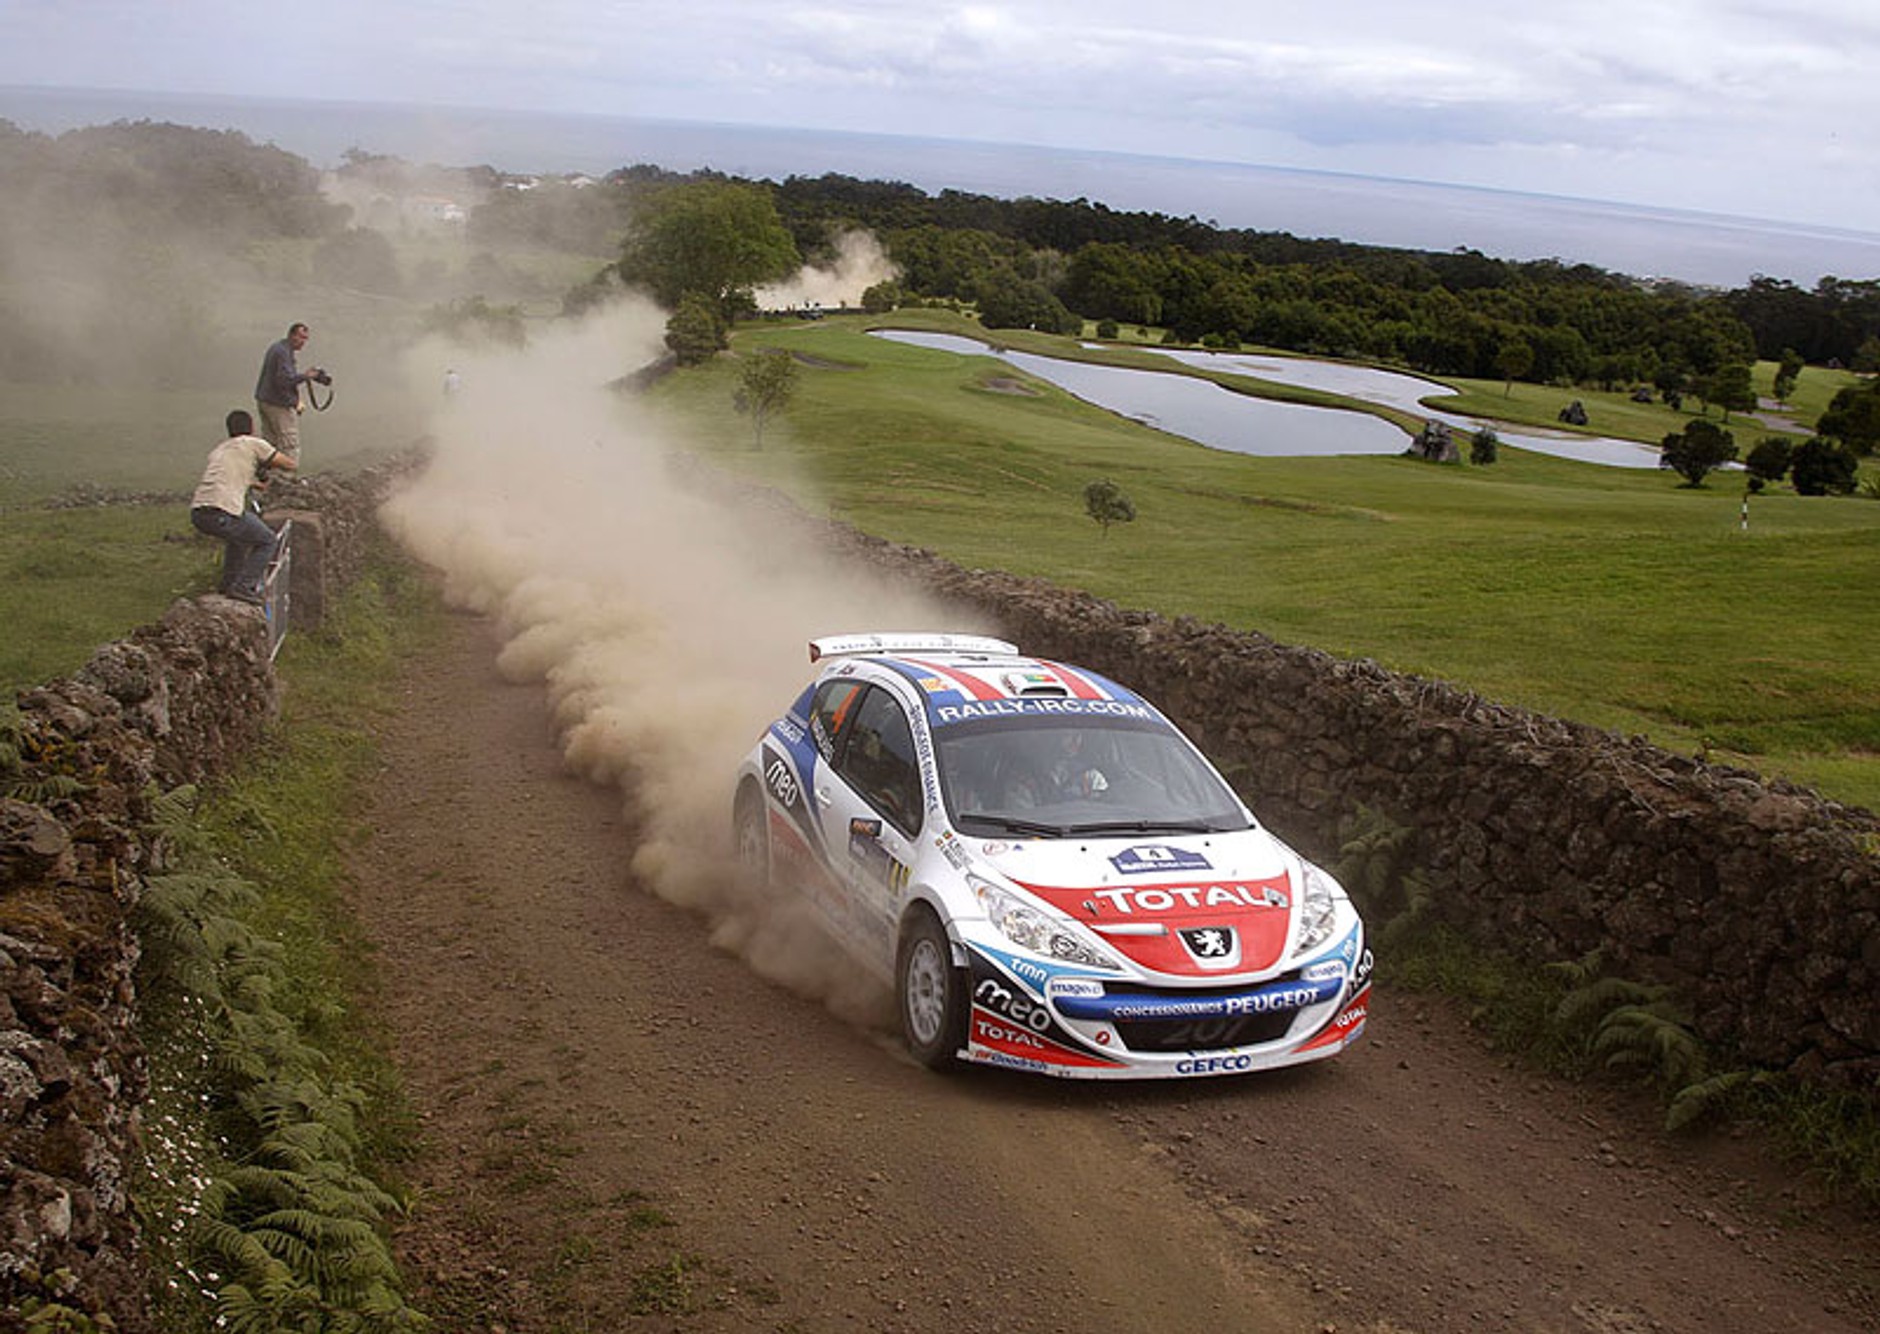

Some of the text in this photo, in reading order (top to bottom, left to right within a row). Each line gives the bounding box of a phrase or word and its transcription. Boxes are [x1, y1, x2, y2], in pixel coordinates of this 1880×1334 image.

[937, 699, 1151, 722] RALLY-IRC.COM
[766, 760, 798, 807] meo
[1093, 885, 1274, 914] TOTAL
[1010, 957, 1047, 982] tmn
[975, 978, 1051, 1031] meo
[1225, 988, 1320, 1014] PEUGEOT
[976, 1021, 1044, 1049] TOTAL
[1176, 1055, 1251, 1074] GEFCO
